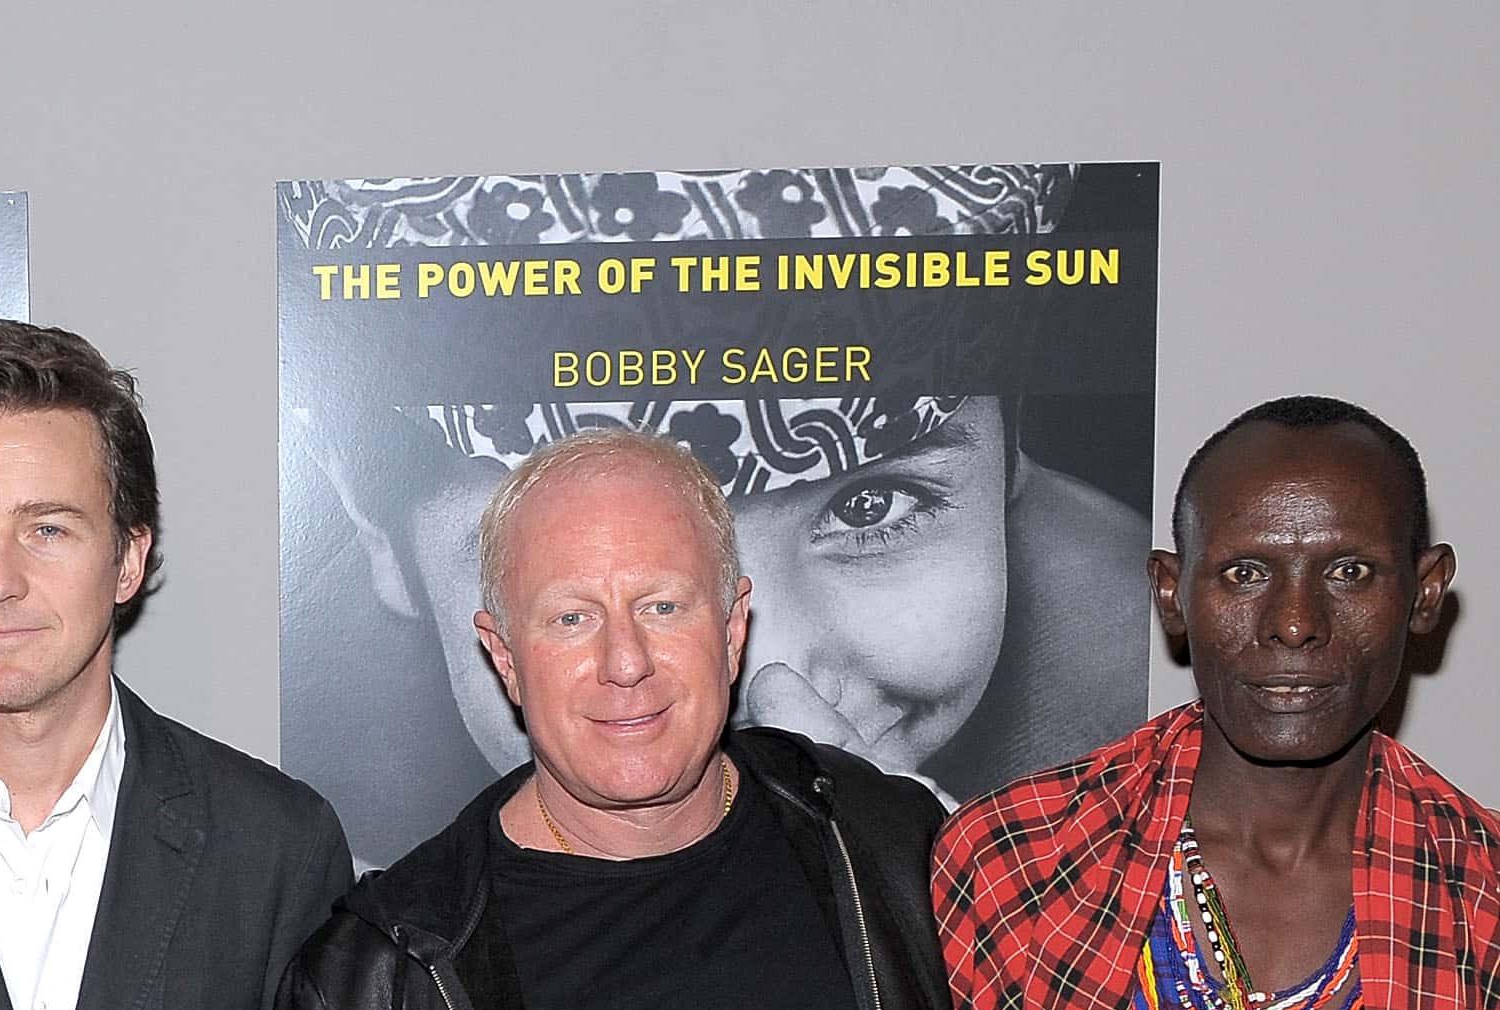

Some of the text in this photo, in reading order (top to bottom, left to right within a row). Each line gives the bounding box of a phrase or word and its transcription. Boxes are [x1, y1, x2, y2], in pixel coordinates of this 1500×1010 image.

[313, 247, 1121, 300] THE POWER OF THE INVISIBLE SUN
[553, 344, 872, 388] BOBBY SAGER
